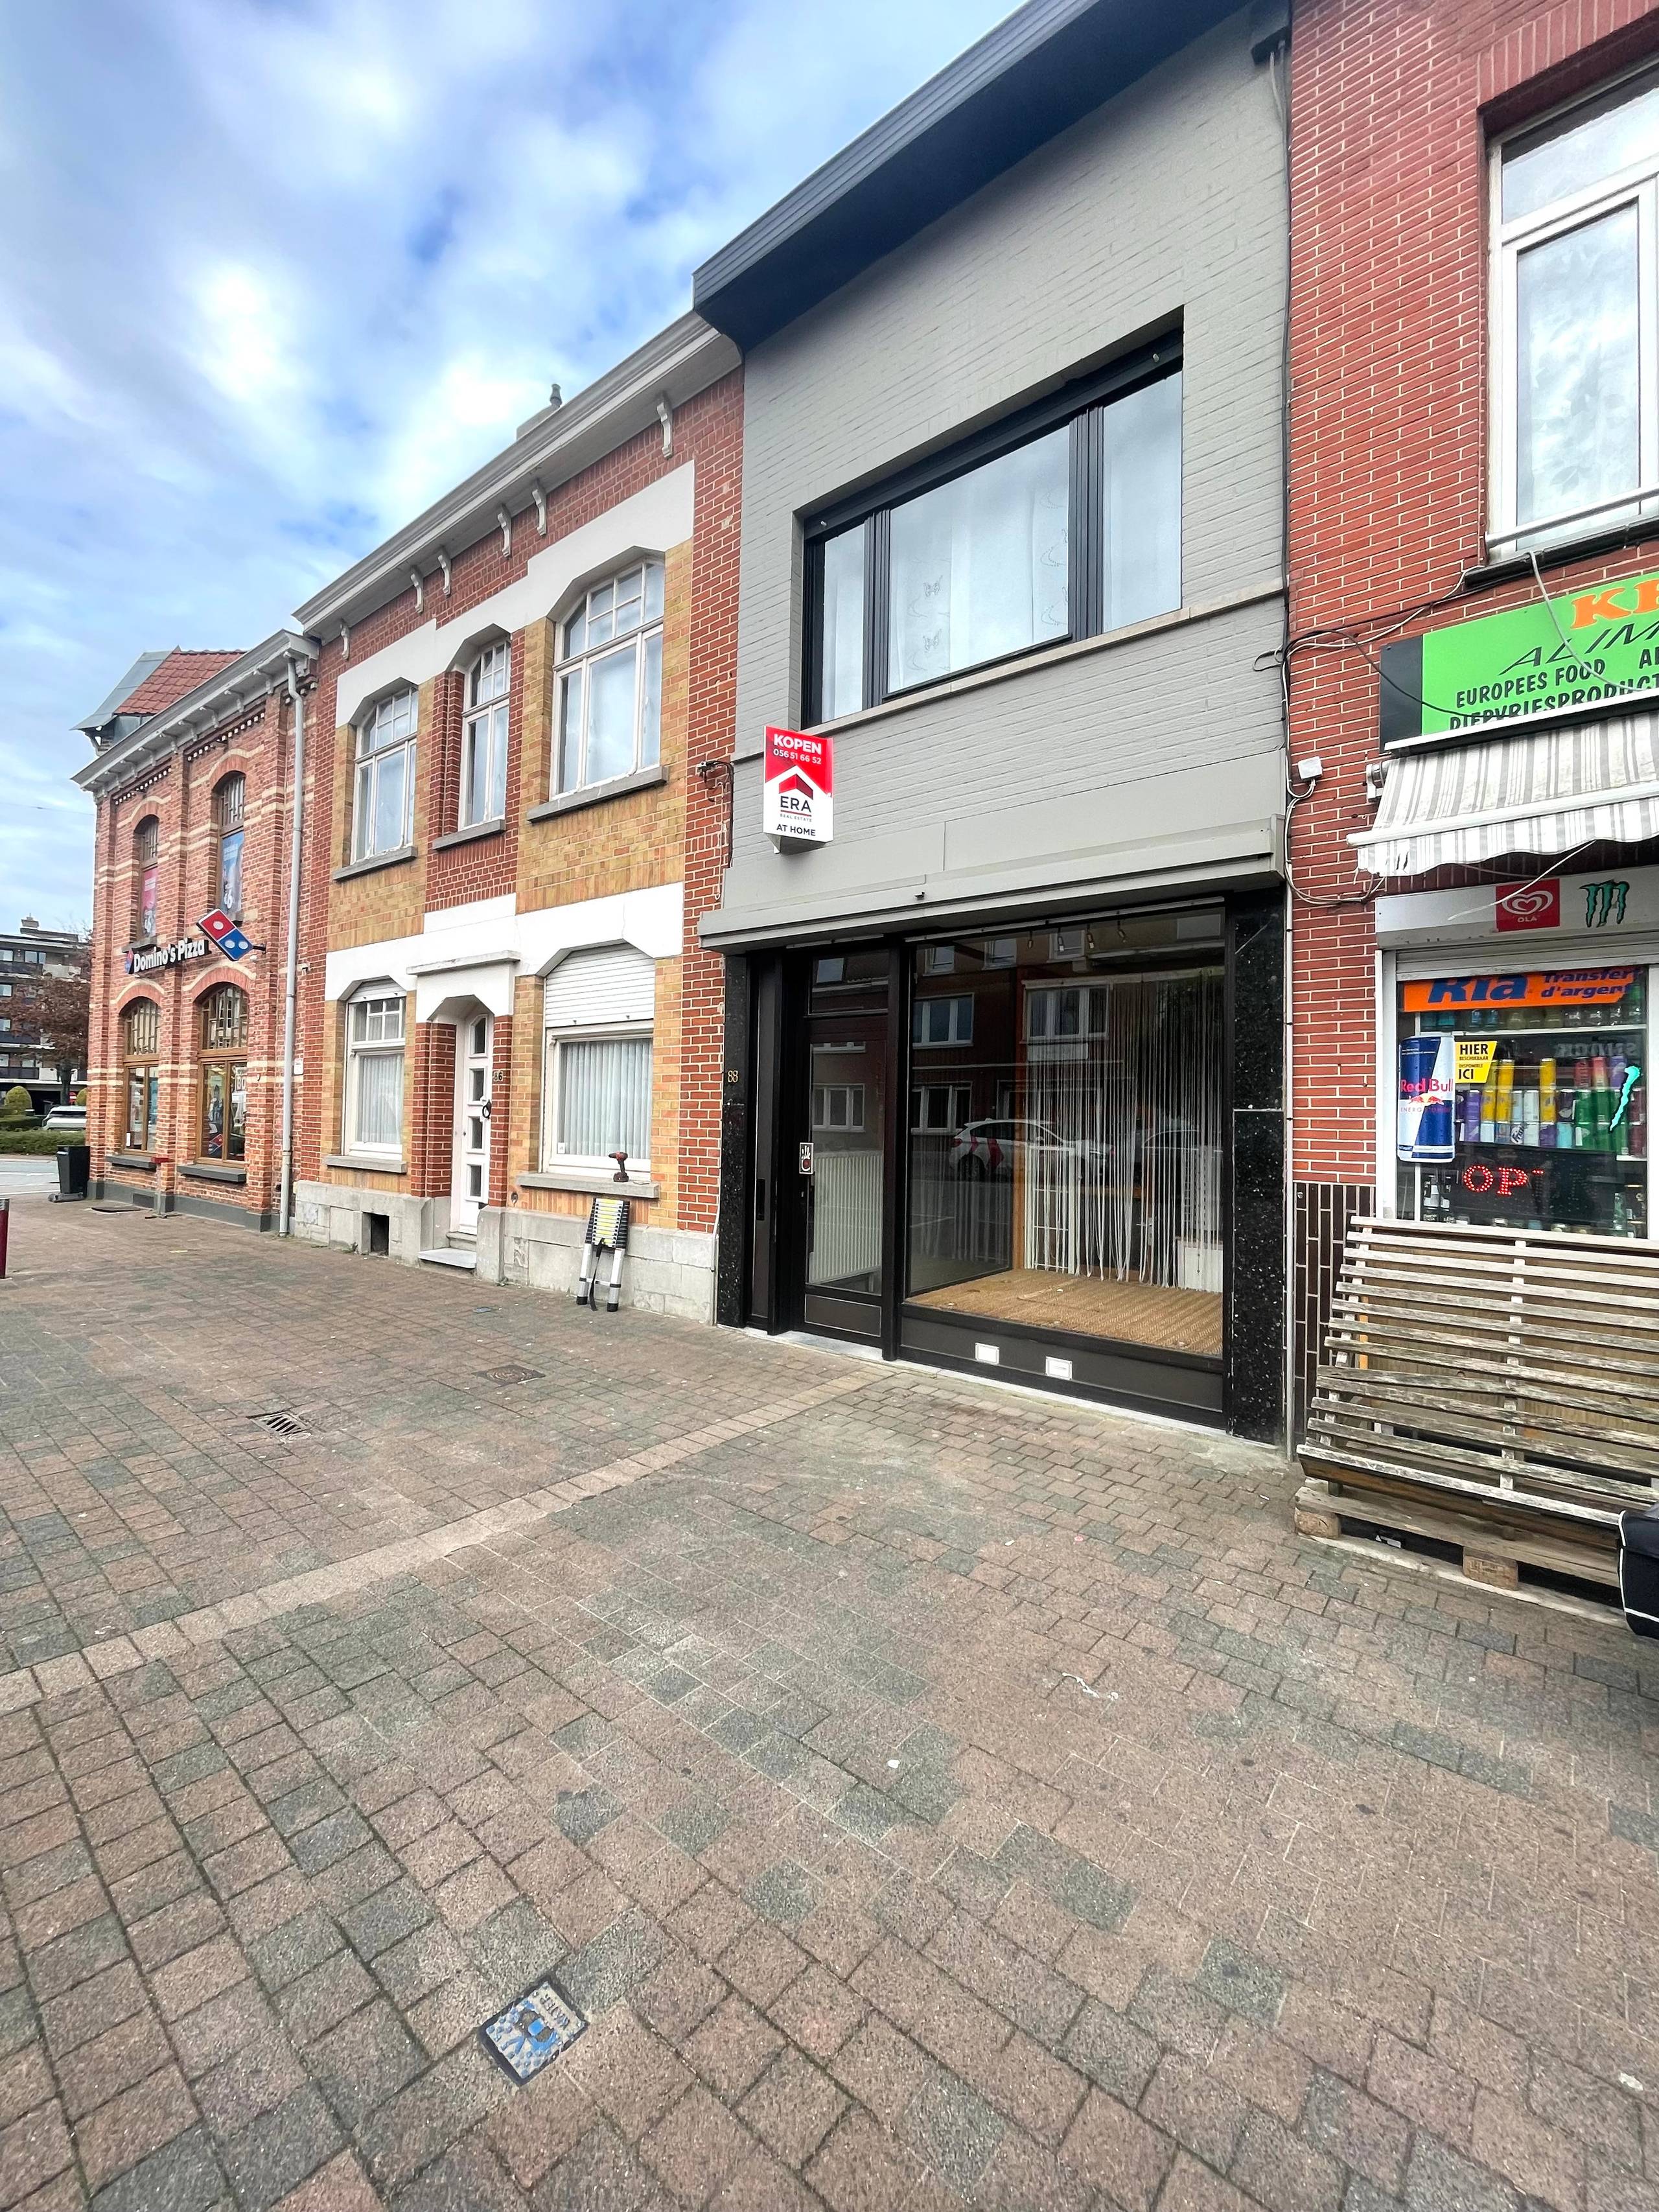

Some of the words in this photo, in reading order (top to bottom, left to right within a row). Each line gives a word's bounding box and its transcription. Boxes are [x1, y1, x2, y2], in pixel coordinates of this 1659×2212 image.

[1456, 671, 1548, 708] EUROPEES
[1555, 658, 1606, 686] FOOD
[774, 734, 822, 755] KOPEN
[773, 748, 789, 758] 056
[800, 754, 810, 762] 66
[780, 795, 812, 813] ERA
[776, 824, 788, 832] AT
[790, 826, 816, 837] HOME
[133, 944, 176, 973] Domino's
[178, 937, 205, 961] Pizza
[1542, 967, 1642, 983] Transfert
[1541, 984, 1632, 999] d'argent
[1459, 1043, 1489, 1055] HIER
[728, 1070, 739, 1083] 88
[1458, 1069, 1474, 1080] ICI
[1400, 1078, 1426, 1093] Red
[1429, 1078, 1454, 1092] Bull
[1463, 1165, 1545, 1196] OP
